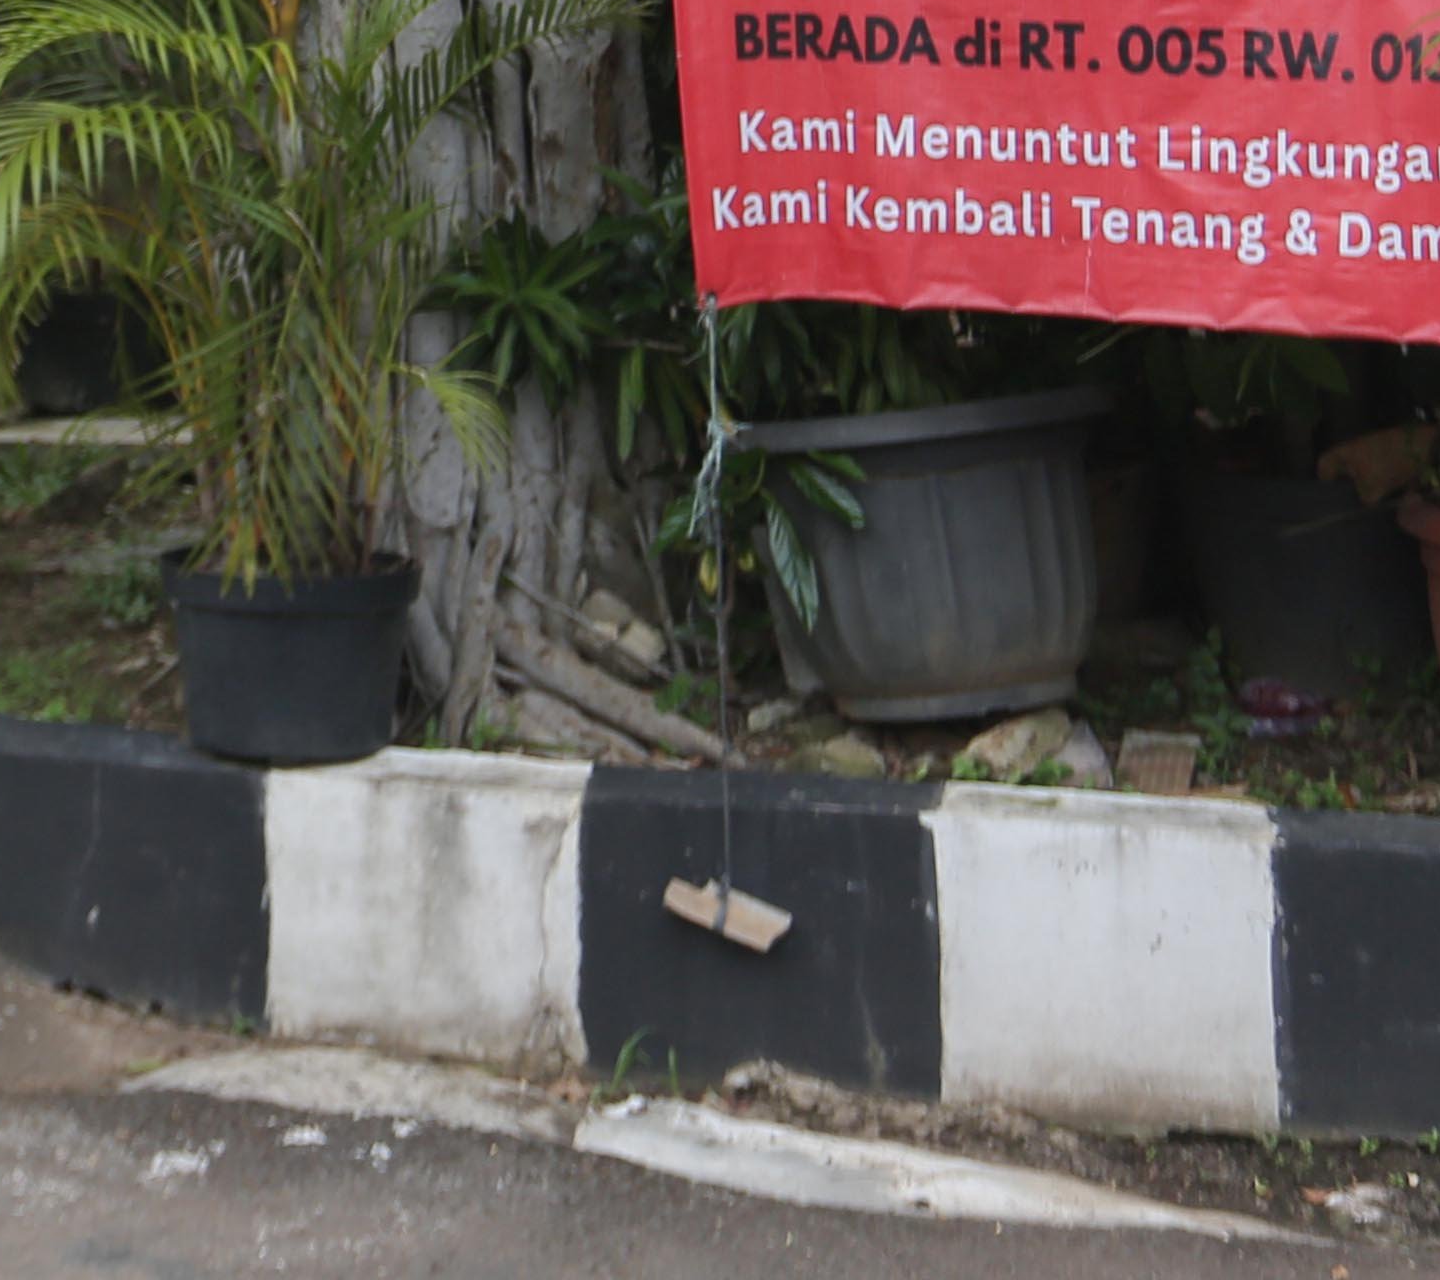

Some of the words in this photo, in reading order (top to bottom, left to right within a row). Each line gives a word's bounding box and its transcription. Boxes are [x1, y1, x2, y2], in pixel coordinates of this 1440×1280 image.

[734, 13, 931, 66] BERADA
[954, 19, 1002, 68] di
[1021, 22, 1099, 72] RT.
[1118, 26, 1226, 76] 005
[1242, 30, 1354, 82] RW.
[739, 110, 856, 154] Kami
[875, 114, 1136, 168] Menuntut
[712, 181, 827, 231] Kami
[845, 186, 1052, 238] Kembali
[1072, 197, 1265, 264] Tenang
[1285, 212, 1317, 256] &
